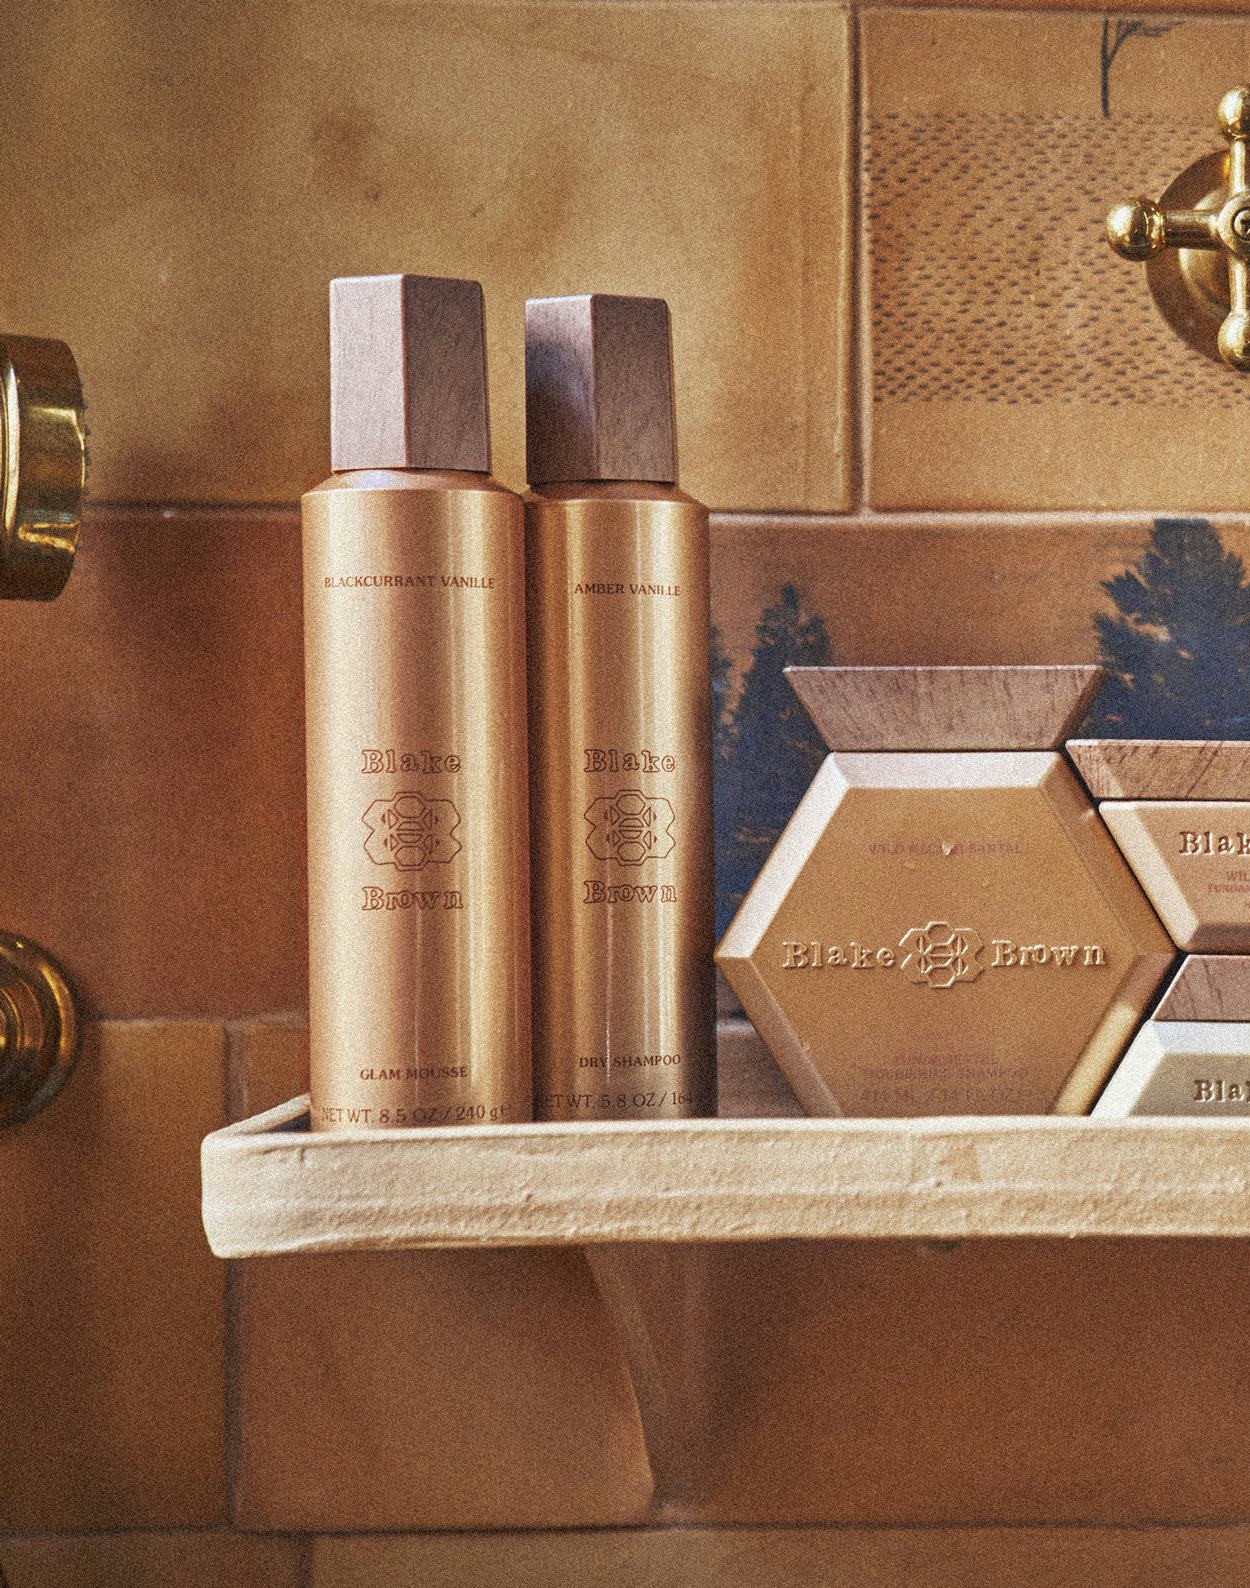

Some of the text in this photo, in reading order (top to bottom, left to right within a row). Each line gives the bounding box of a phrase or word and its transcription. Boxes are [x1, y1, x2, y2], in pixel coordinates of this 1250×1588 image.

[324, 574, 495, 589] BLACKCURRANT VANILLE
[574, 583, 681, 596] AMBER VANILLE
[361, 749, 462, 774] Blake
[583, 748, 677, 774] Blake
[361, 885, 464, 911] Brown
[583, 879, 678, 905] Brown
[782, 939, 1107, 970] Blake Brown
[579, 1053, 682, 1068] DRY SHAMPOO
[359, 1066, 468, 1081] GLAM MOUSSE
[600, 1094, 627, 1108] 5.8
[632, 1092, 656, 1107] OZ
[322, 1107, 343, 1123] NET
[378, 1108, 407, 1123] 8.5
[413, 1106, 436, 1122] OZ
[455, 1104, 486, 1121] 240
